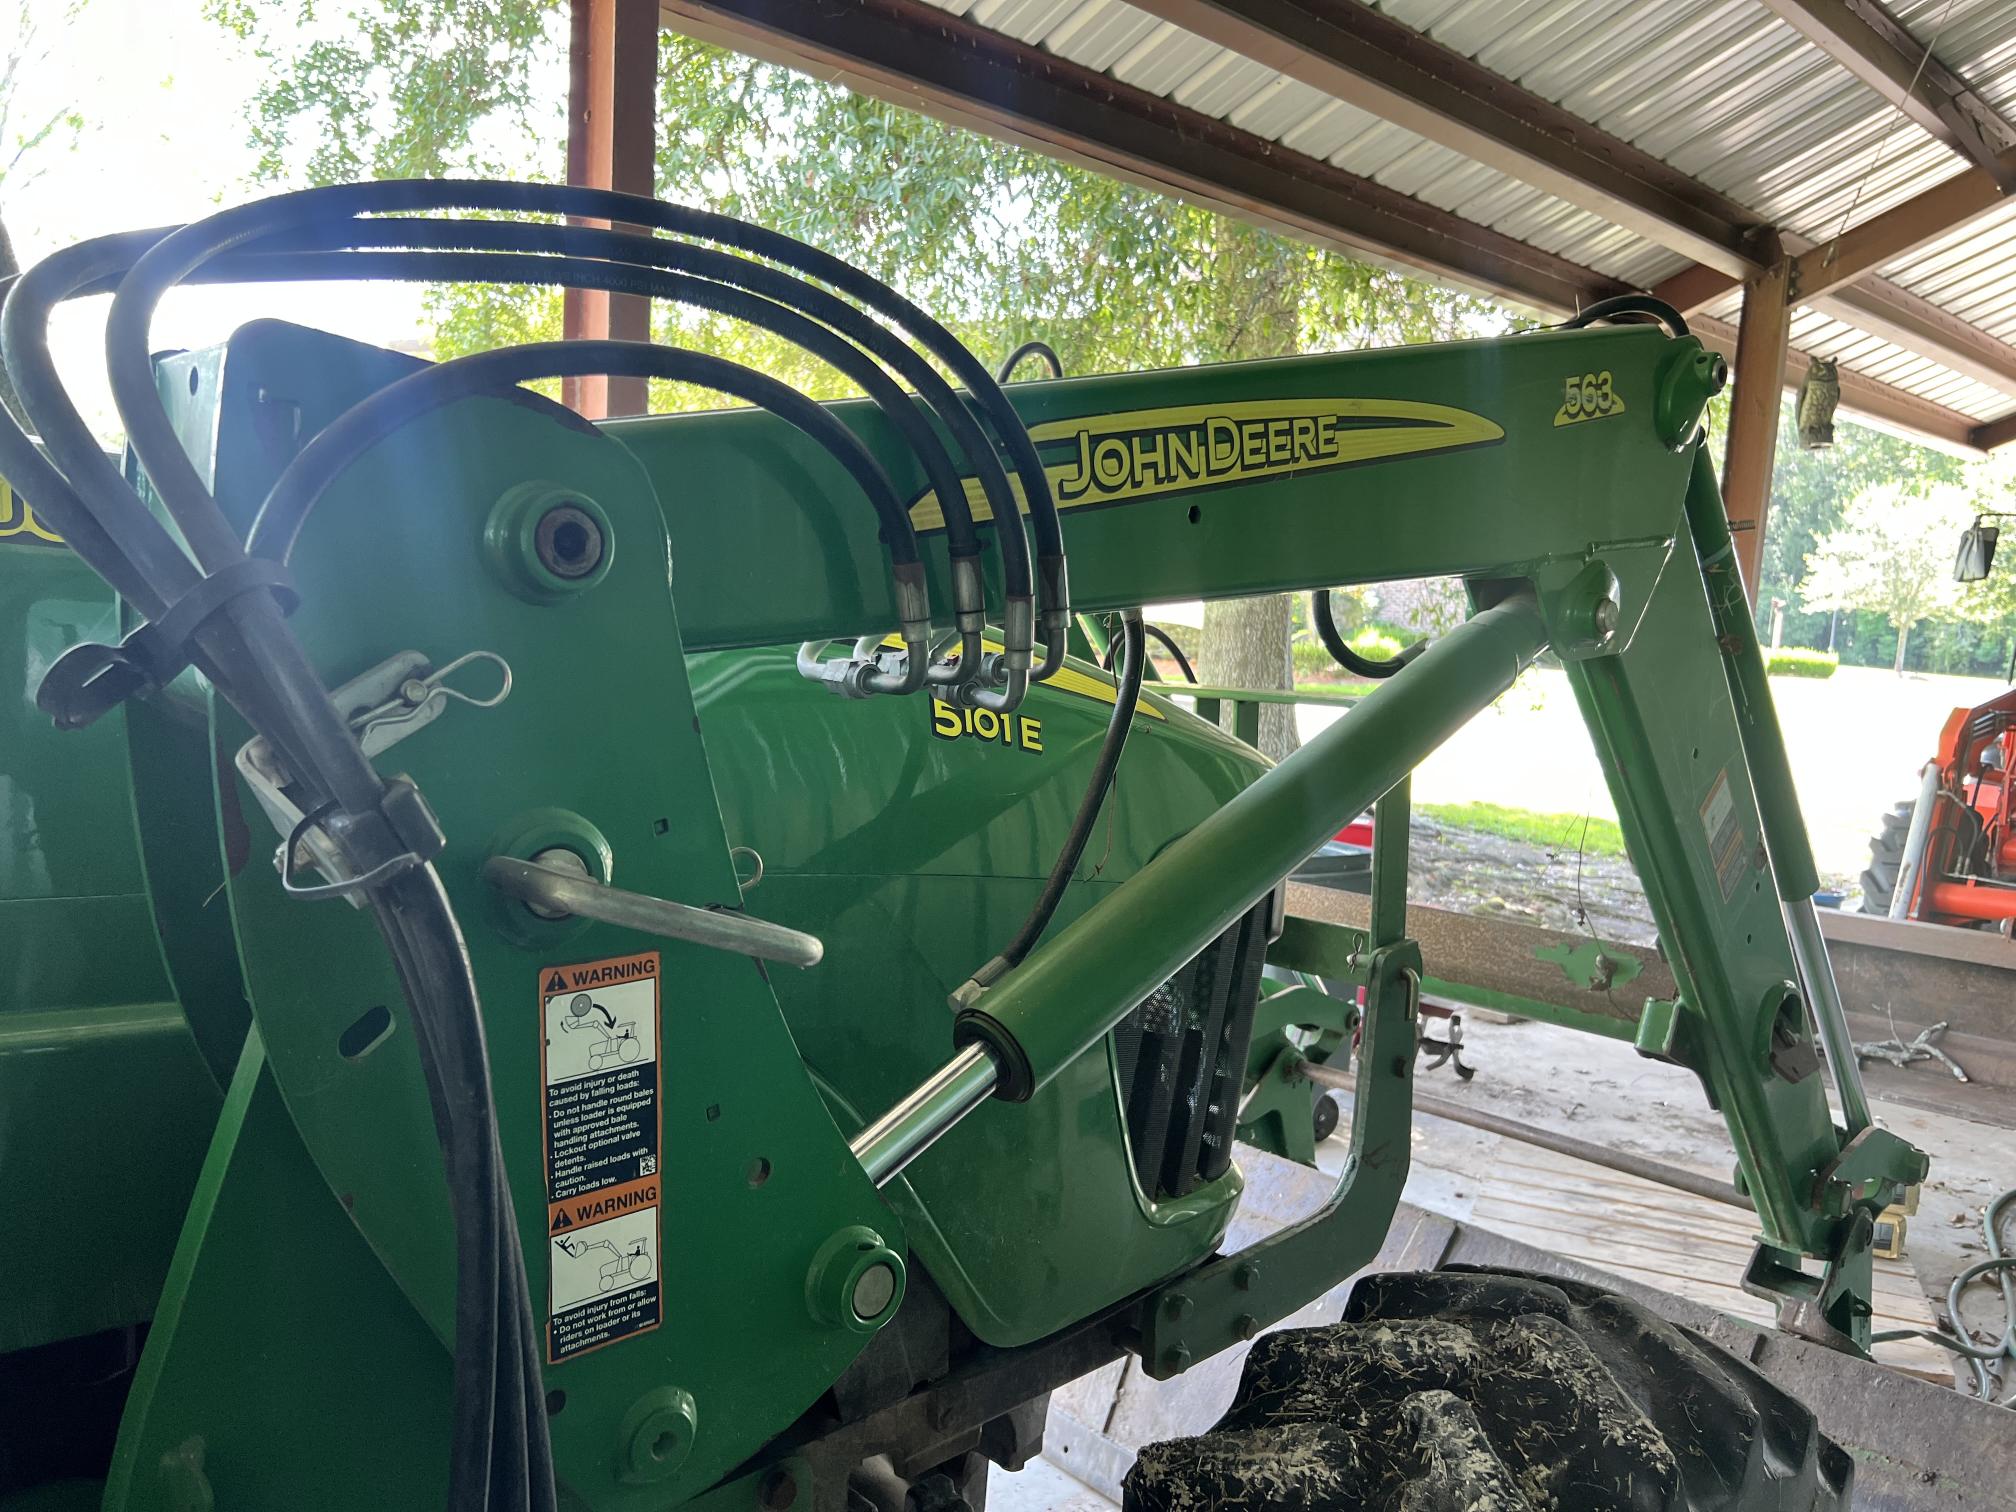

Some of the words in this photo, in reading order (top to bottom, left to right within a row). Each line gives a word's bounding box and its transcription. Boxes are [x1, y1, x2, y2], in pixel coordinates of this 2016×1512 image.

[1565, 369, 1613, 419] 563
[1059, 430, 1200, 500] JOHN
[1204, 414, 1339, 472] DEERE
[572, 959, 655, 987] WARNING
[549, 1088, 559, 1097] To
[560, 1083, 582, 1095] avoid
[583, 1078, 606, 1090] injury
[607, 1075, 616, 1083] or
[617, 1070, 639, 1081] death
[549, 1094, 579, 1107] caused
[580, 1091, 590, 1101] by
[591, 1085, 615, 1097] falling
[616, 1080, 640, 1091] loads:
[553, 1110, 565, 1118] Do
[567, 1106, 580, 1116] not
[581, 1098, 608, 1111] handle
[610, 1092, 633, 1104] round
[634, 1088, 654, 1099] bales
[553, 1116, 580, 1128] unless
[581, 1110, 606, 1122] loader
[608, 1107, 615, 1117] is
[616, 1097, 651, 1113] equipped
[553, 1126, 571, 1139] with
[572, 1118, 610, 1135] approved
[611, 1114, 628, 1124] bale
[553, 1134, 588, 1149] handling
[589, 1121, 640, 1140] attachments.
[554, 1144, 587, 1159] Lockout
[588, 1135, 620, 1150] optional
[621, 1130, 641, 1141] valve
[554, 1156, 587, 1169] detents.
[555, 1165, 583, 1179] Handle
[584, 1158, 609, 1171] raised
[610, 1152, 631, 1164] loads
[632, 1147, 649, 1157] with
[555, 1176, 587, 1189] caution.
[555, 1185, 577, 1199] Carry
[578, 1180, 600, 1192] loads
[601, 1176, 617, 1186] low.
[576, 1186, 657, 1222] WARNING
[553, 1317, 563, 1326] To
[564, 1309, 586, 1324] avoid
[587, 1300, 608, 1316] injury
[609, 1295, 628, 1307] from
[629, 1289, 646, 1301] falls:
[559, 1324, 571, 1334] Do
[572, 1318, 586, 1330] not
[587, 1312, 607, 1326] work
[608, 1306, 626, 1318] from
[627, 1303, 636, 1312] or
[637, 1295, 657, 1308] allow
[559, 1330, 583, 1344] riders
[584, 1326, 595, 1335] on
[596, 1317, 621, 1333] loader
[622, 1314, 631, 1323] or
[631, 1310, 641, 1320] its
[560, 1331, 611, 1354] attachments.
